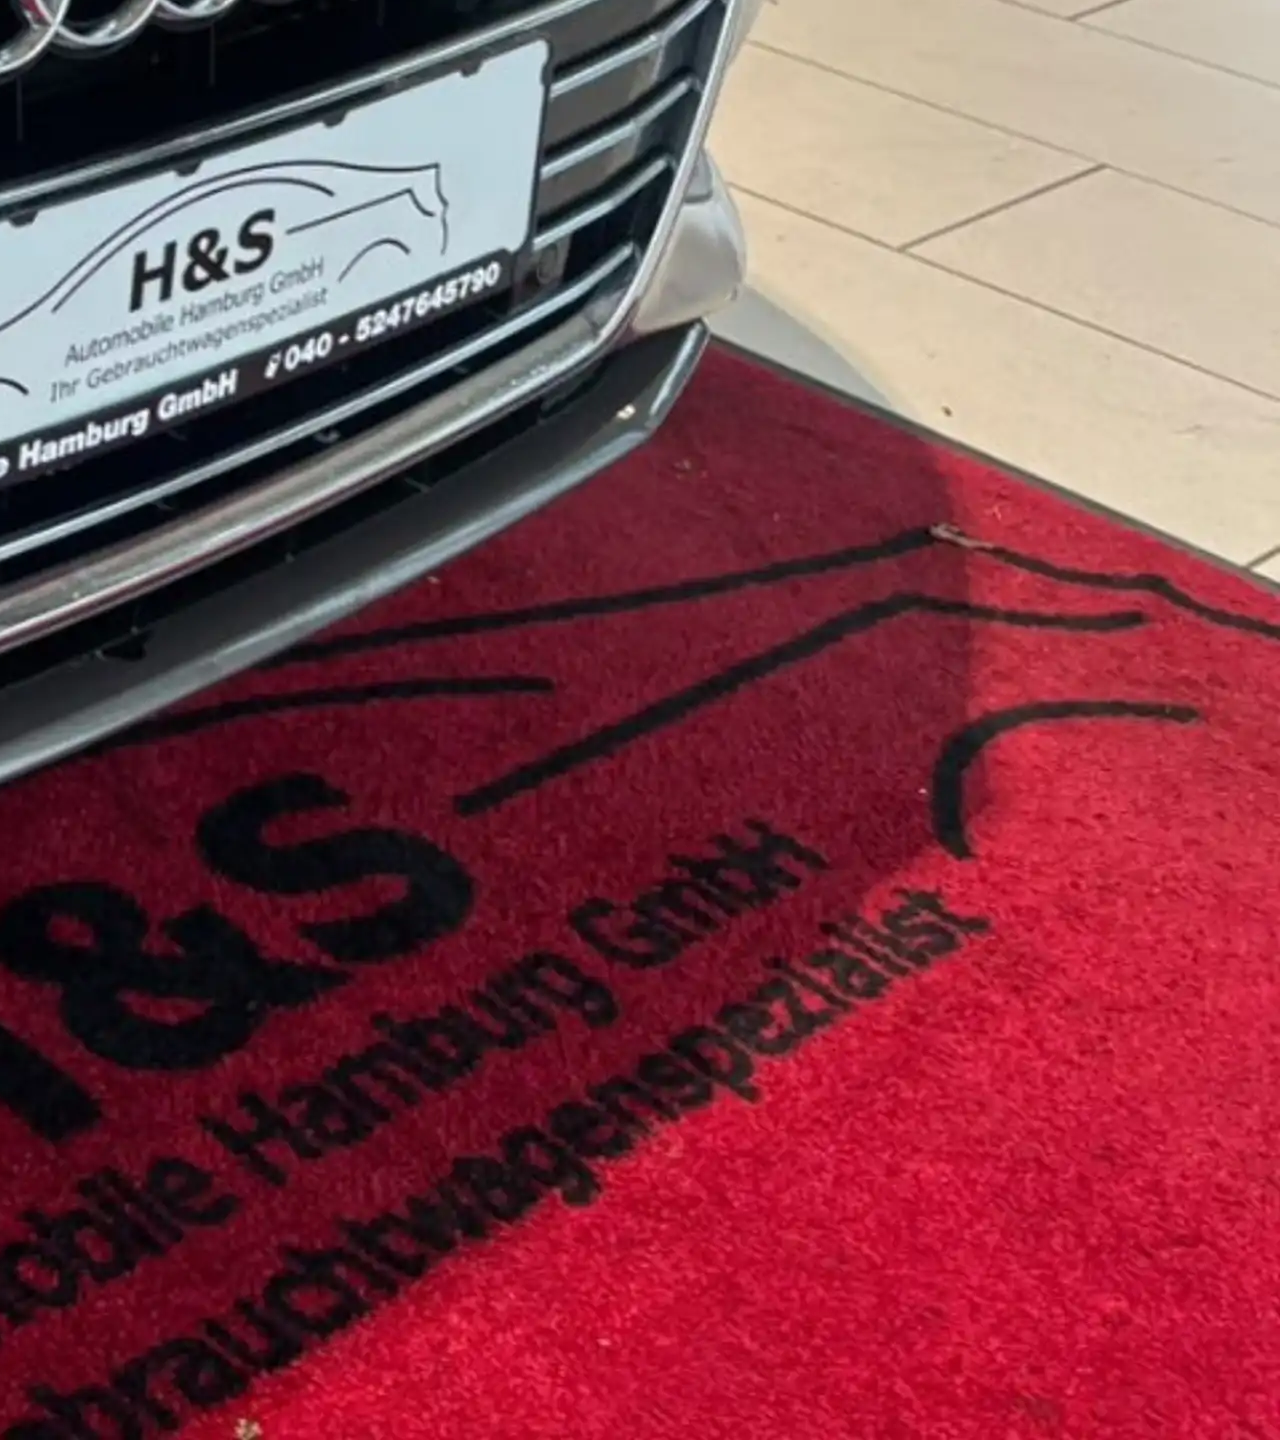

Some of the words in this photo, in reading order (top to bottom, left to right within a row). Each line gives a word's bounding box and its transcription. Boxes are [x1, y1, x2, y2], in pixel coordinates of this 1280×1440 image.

[63, 313, 176, 369] Automobile
[179, 281, 265, 327] Hamburg
[269, 255, 326, 295] GmbH
[129, 207, 276, 313] H&S
[17, 404, 149, 471] Hamburg
[156, 368, 240, 421] GmbH
[283, 331, 333, 371] 040
[49, 377, 80, 404] Ihr
[85, 286, 329, 390] Gebrauchtwagenspezialist
[201, 952, 619, 1186] Hamburg
[570, 818, 828, 968] GmbH
